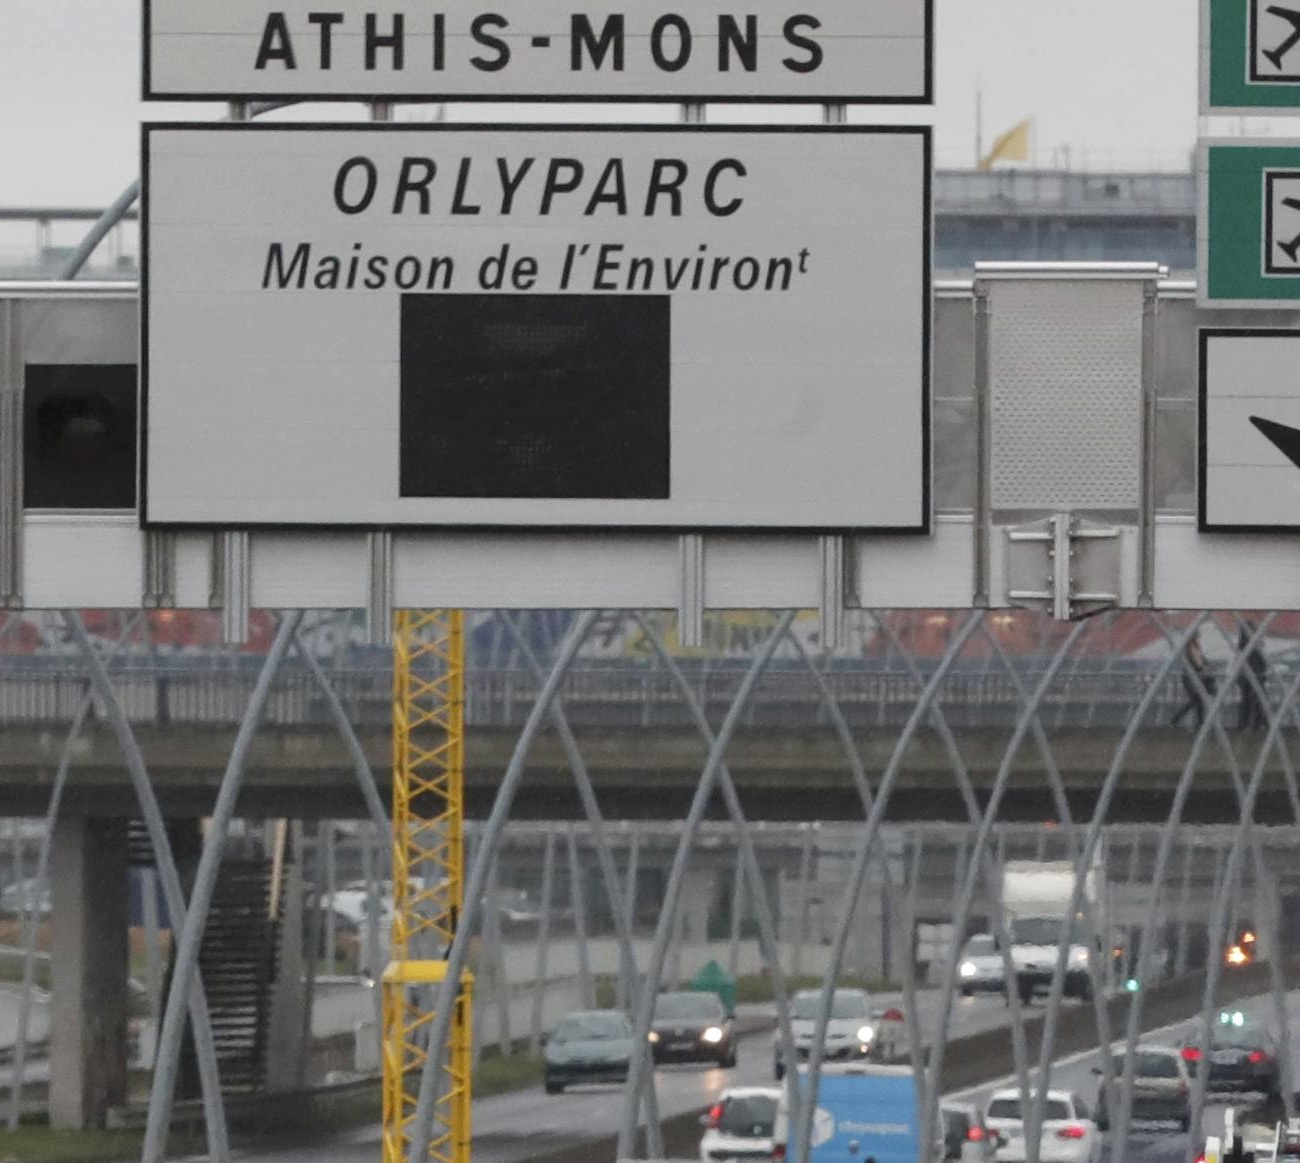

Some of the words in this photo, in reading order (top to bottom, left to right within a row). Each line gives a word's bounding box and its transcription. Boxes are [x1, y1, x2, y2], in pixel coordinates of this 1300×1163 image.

[254, 12, 825, 73] ATHIS-MONS
[333, 156, 748, 217] ORLYPARC
[262, 242, 454, 291] Maison
[478, 243, 539, 291] de
